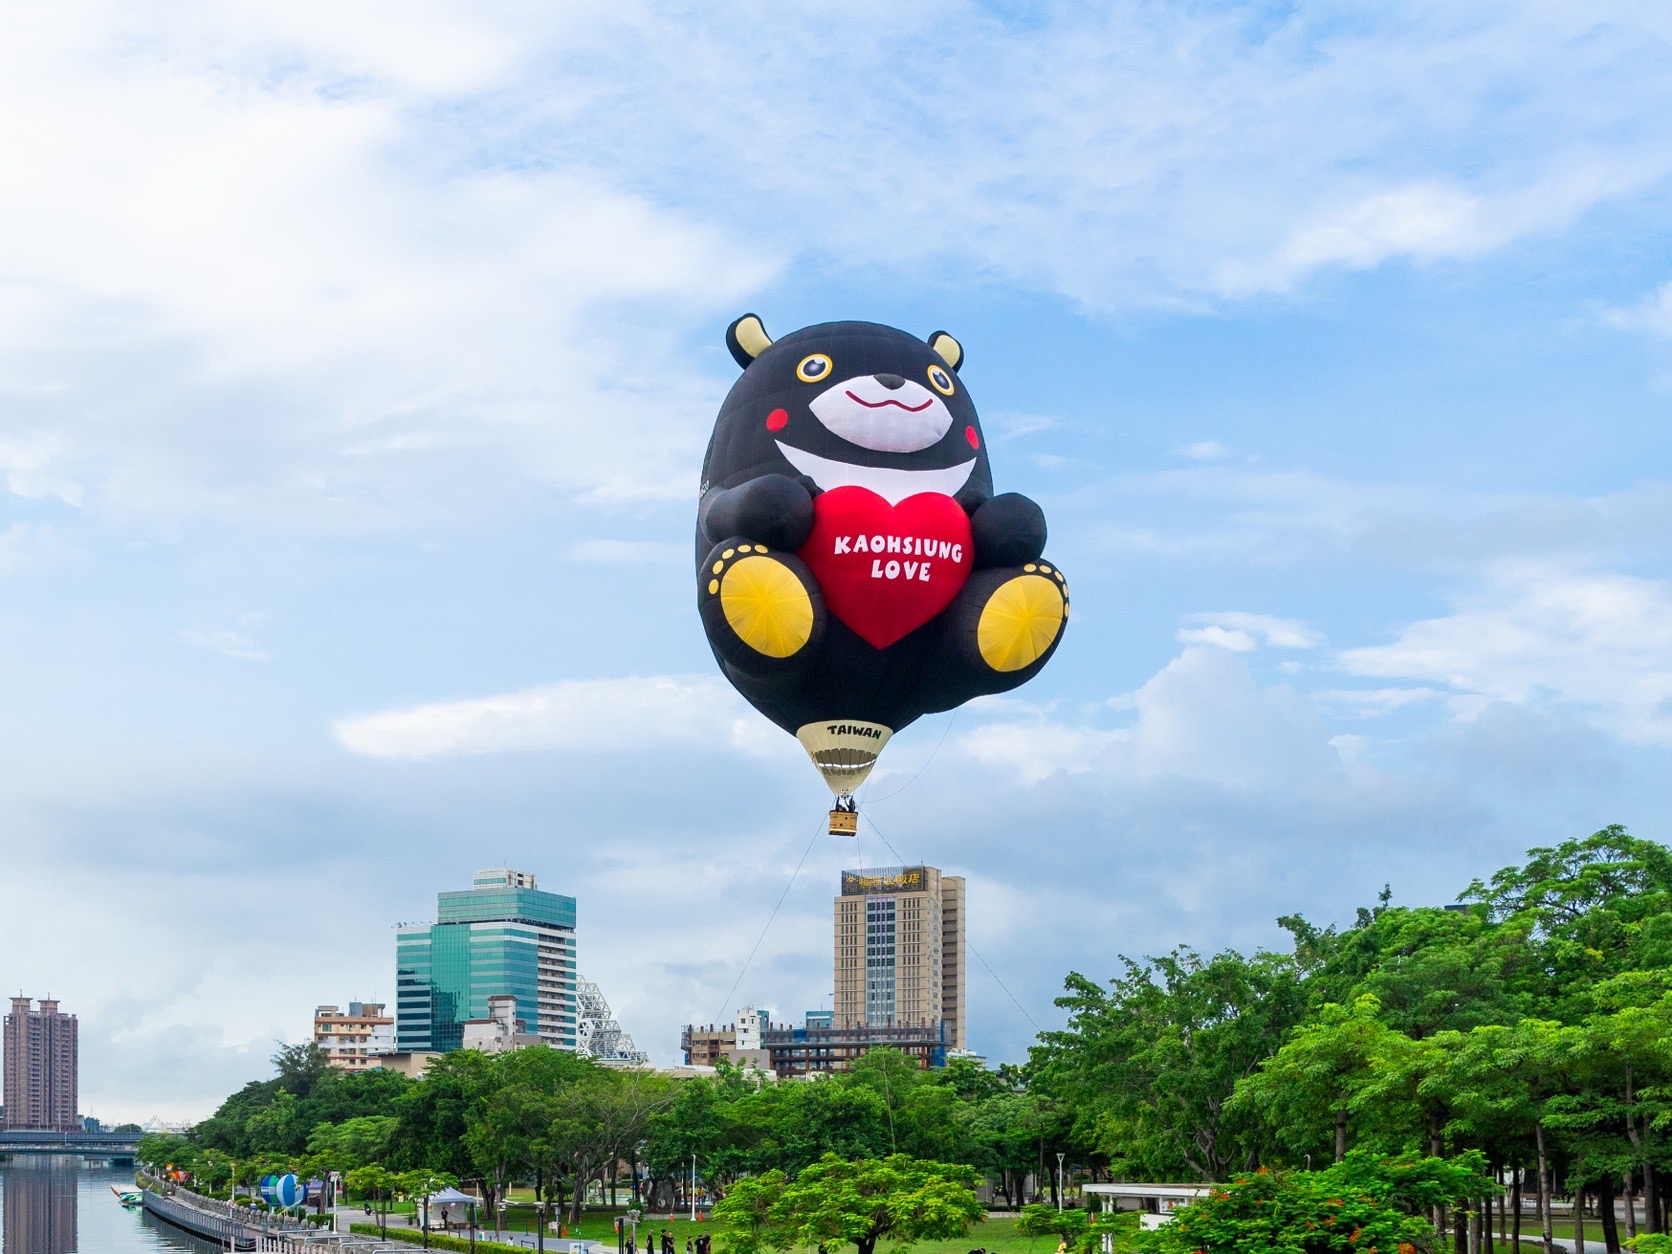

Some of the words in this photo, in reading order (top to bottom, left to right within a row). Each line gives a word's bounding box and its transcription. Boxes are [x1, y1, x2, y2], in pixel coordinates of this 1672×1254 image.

[834, 534, 963, 563] KAOHSIUNG
[871, 559, 931, 582] LOVE
[828, 725, 882, 739] TAIWAN
